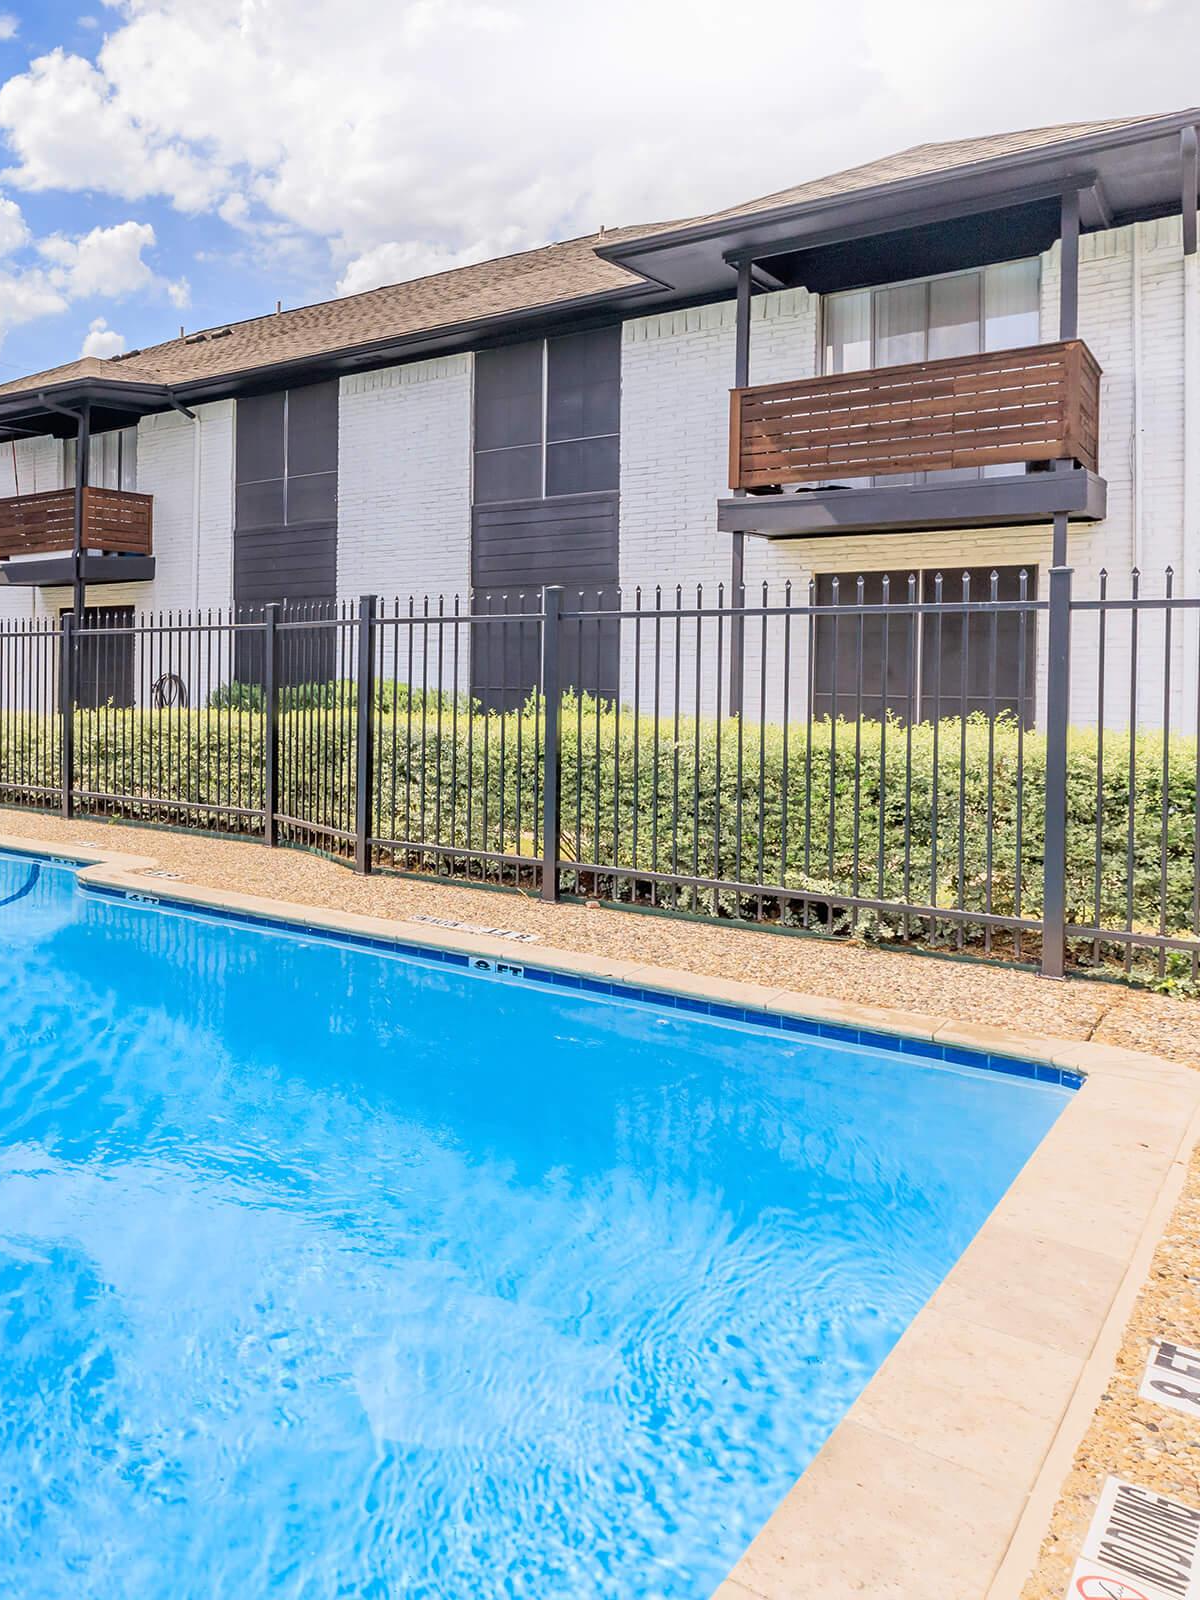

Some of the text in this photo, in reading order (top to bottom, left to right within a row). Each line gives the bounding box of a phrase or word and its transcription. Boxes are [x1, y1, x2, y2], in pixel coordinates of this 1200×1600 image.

[497, 963, 522, 977] FT
[1097, 1485, 1200, 1597] NO DIVING
